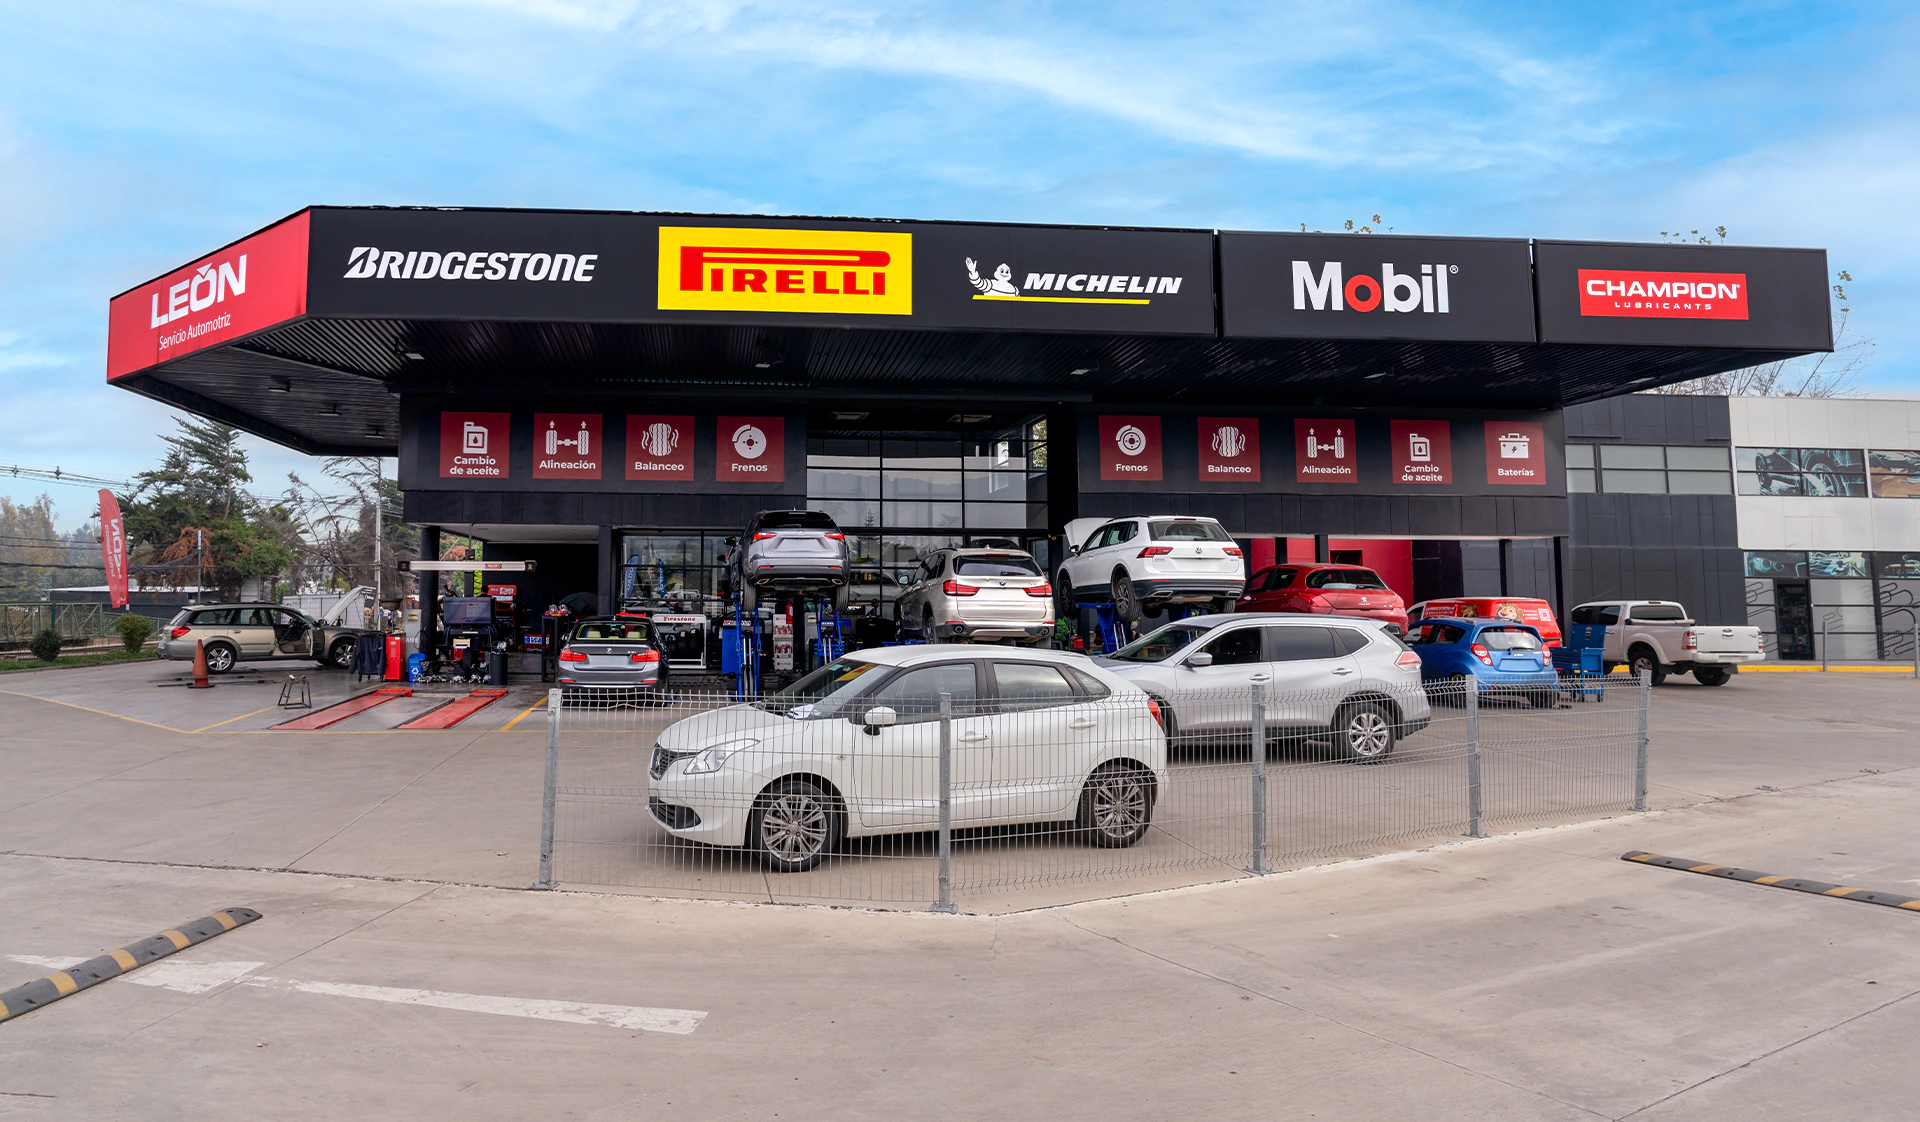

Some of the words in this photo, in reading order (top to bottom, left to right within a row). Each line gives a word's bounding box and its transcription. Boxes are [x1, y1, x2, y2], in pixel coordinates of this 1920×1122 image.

[343, 246, 599, 282] BRIDGESTONE
[679, 245, 891, 296] PIRELLI
[1023, 272, 1183, 294] MICHELIN
[1291, 260, 1450, 313] Mobil
[1586, 279, 1738, 300] CHAMPION
[1615, 301, 1712, 311] LUBRICANTS
[159, 329, 186, 351] Servicio
[187, 312, 231, 340] Automotriz
[453, 455, 496, 466] Cambio
[539, 459, 596, 470] Alineación
[449, 465, 465, 475] de
[466, 466, 500, 476] aceite
[634, 461, 684, 472] Balanceo
[731, 462, 768, 473] Frenos
[1115, 463, 1148, 472] Frenos
[1207, 464, 1251, 474] Balanceo
[1302, 464, 1351, 475] Alineación
[1404, 464, 1439, 473] Cambio
[1497, 467, 1534, 477] Baterías
[1401, 473, 1414, 482] de
[1415, 473, 1443, 482] aceite
